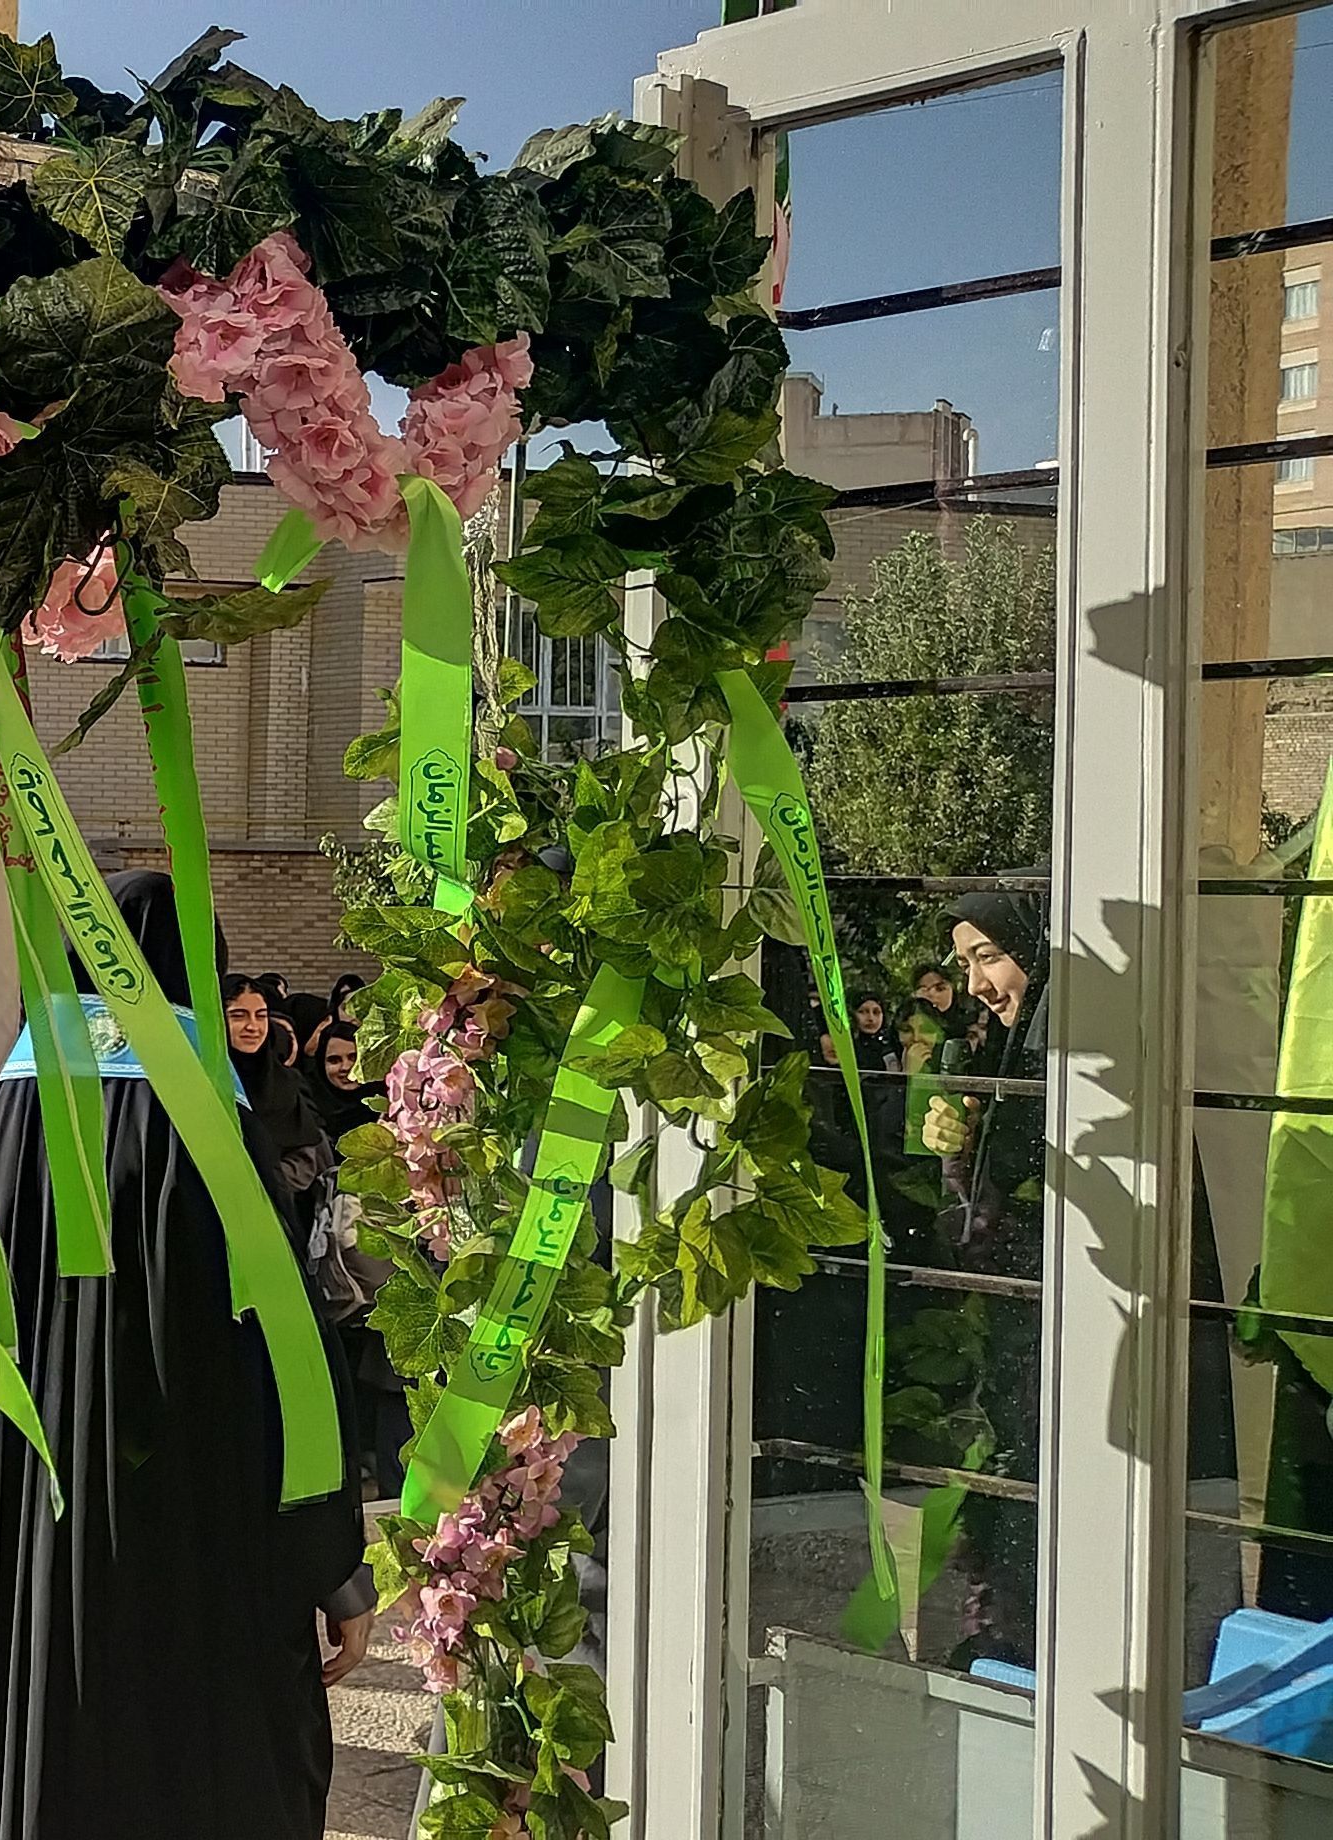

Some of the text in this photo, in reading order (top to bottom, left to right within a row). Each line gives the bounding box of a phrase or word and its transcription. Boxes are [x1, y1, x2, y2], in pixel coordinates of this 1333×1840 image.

[417, 762, 455, 832] الزمان
[779, 806, 820, 891] الزمان
[67, 902, 136, 991] الزمان
[533, 1175, 579, 1259] الزمان
